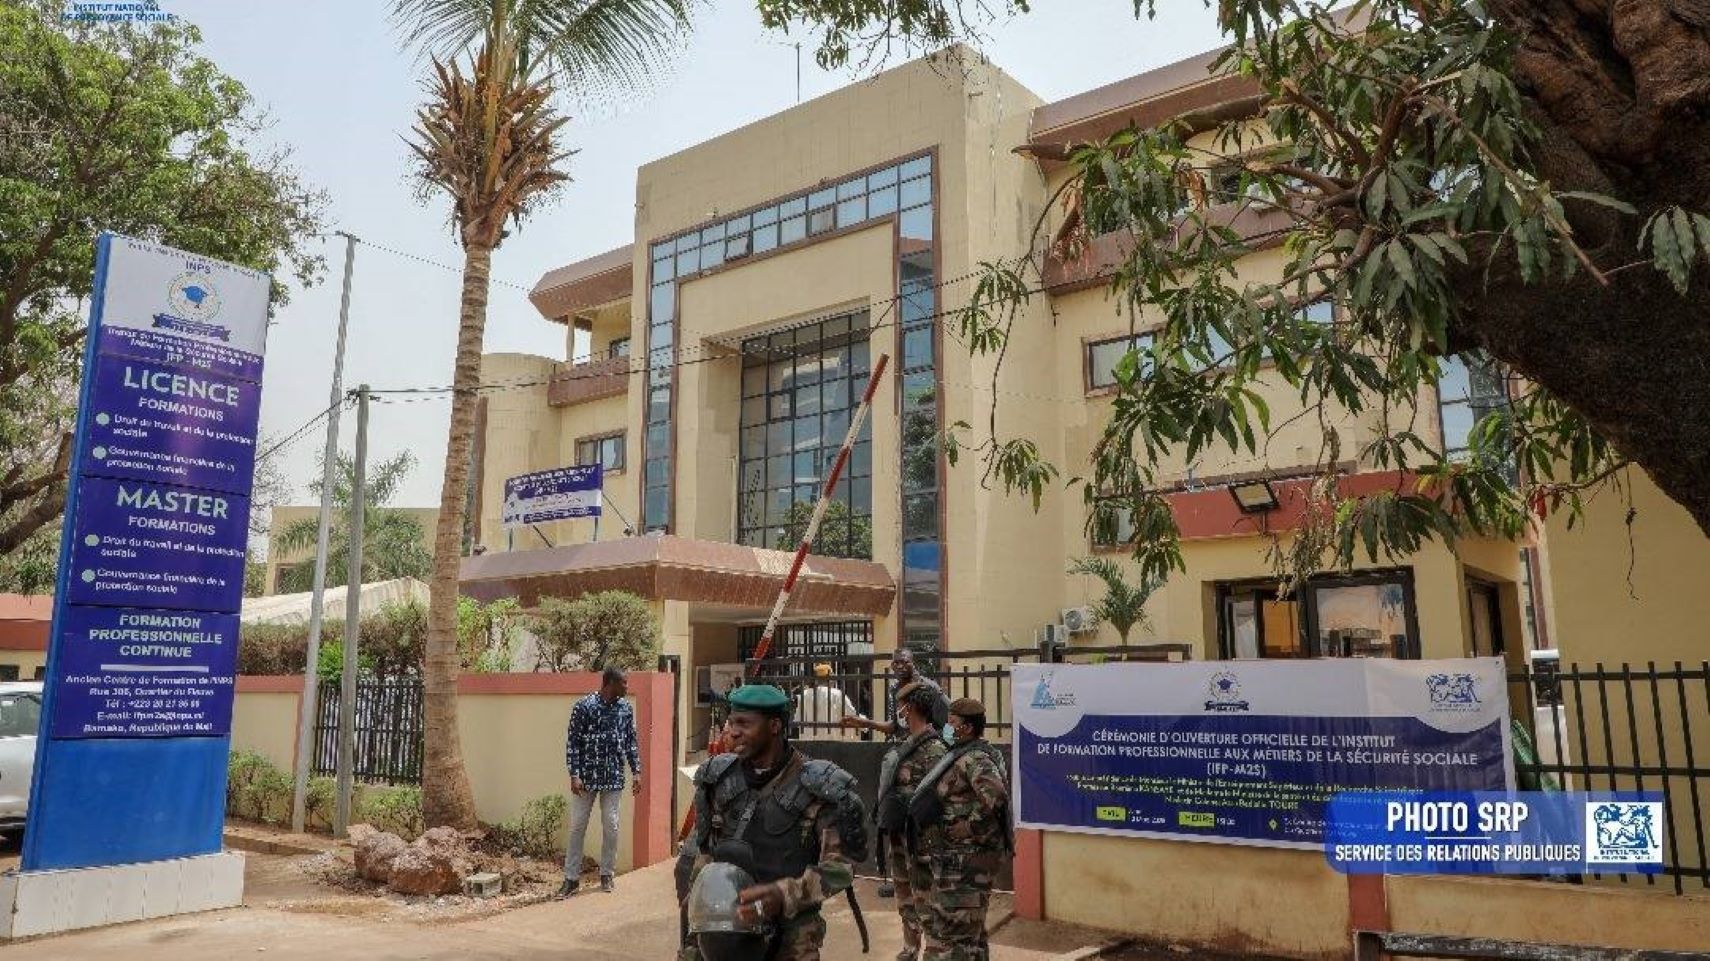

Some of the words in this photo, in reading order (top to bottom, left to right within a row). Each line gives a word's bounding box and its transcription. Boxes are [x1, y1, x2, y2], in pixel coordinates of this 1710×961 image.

[124, 366, 240, 407] LICENCE
[138, 396, 224, 422] FORMATIONS
[116, 484, 229, 520] MASTER
[128, 515, 216, 536] FORMATIONS
[120, 614, 201, 629] FORMATION
[89, 629, 222, 645] PROFESSIONNELLE
[119, 645, 192, 658] CONTINUE
[152, 675, 197, 686] Formation
[89, 687, 110, 696] Rue
[1092, 729, 1156, 743] CÉRÉMONIE
[1159, 732, 1239, 745] D'OUVERTURE
[1241, 733, 1308, 746] OFFICIELLE
[1311, 735, 1329, 746] DE
[1332, 735, 1396, 748] L'INSTITUT
[1037, 744, 1051, 755] DE
[1053, 744, 1116, 757] FORMATION
[1118, 745, 1221, 759] PROFESSIONNELLE
[1223, 748, 1250, 760] AUX
[1252, 747, 1302, 762] MÉTIERS
[1306, 751, 1323, 762] DE
[1327, 751, 1343, 763] LA
[1346, 748, 1410, 765] SÉCURITÉ
[1413, 752, 1479, 766] SOCIALE
[1206, 763, 1267, 779] (IFP-M2S)
